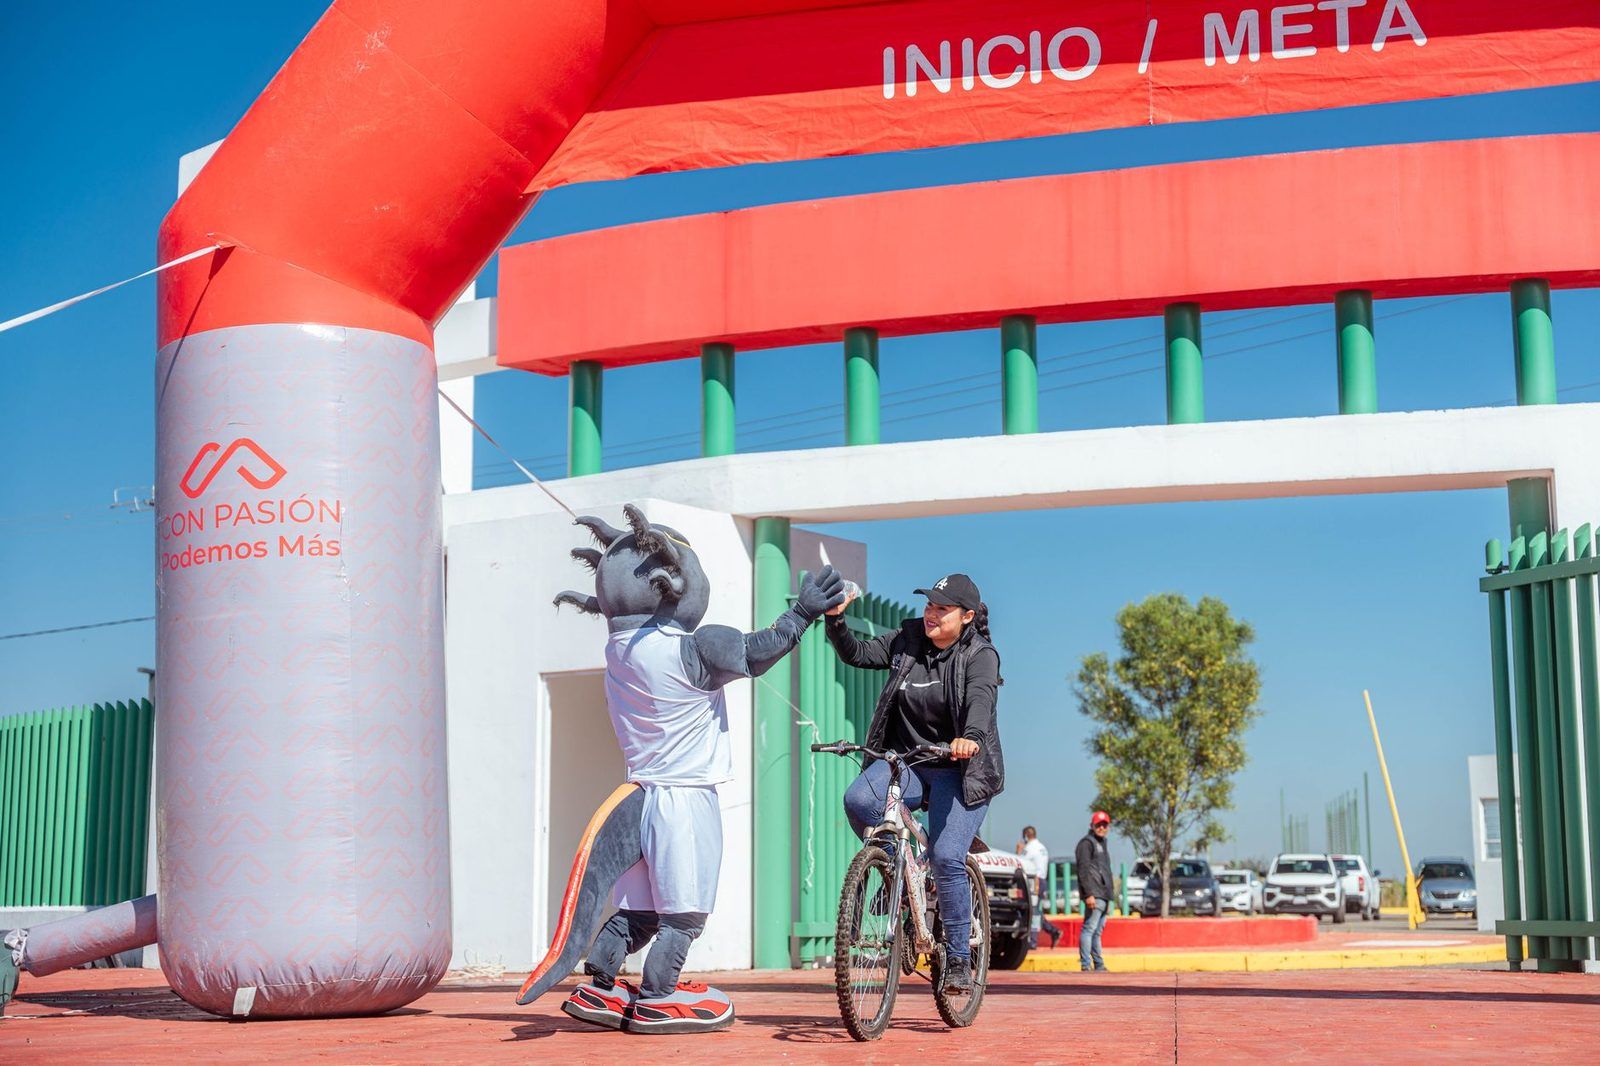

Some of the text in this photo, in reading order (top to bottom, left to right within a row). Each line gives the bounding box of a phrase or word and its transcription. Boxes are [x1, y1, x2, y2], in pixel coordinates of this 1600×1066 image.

[883, 0, 1428, 99] INICIO / META
[160, 494, 340, 541] CON PASIÓN
[162, 534, 340, 571] Podemos Más
